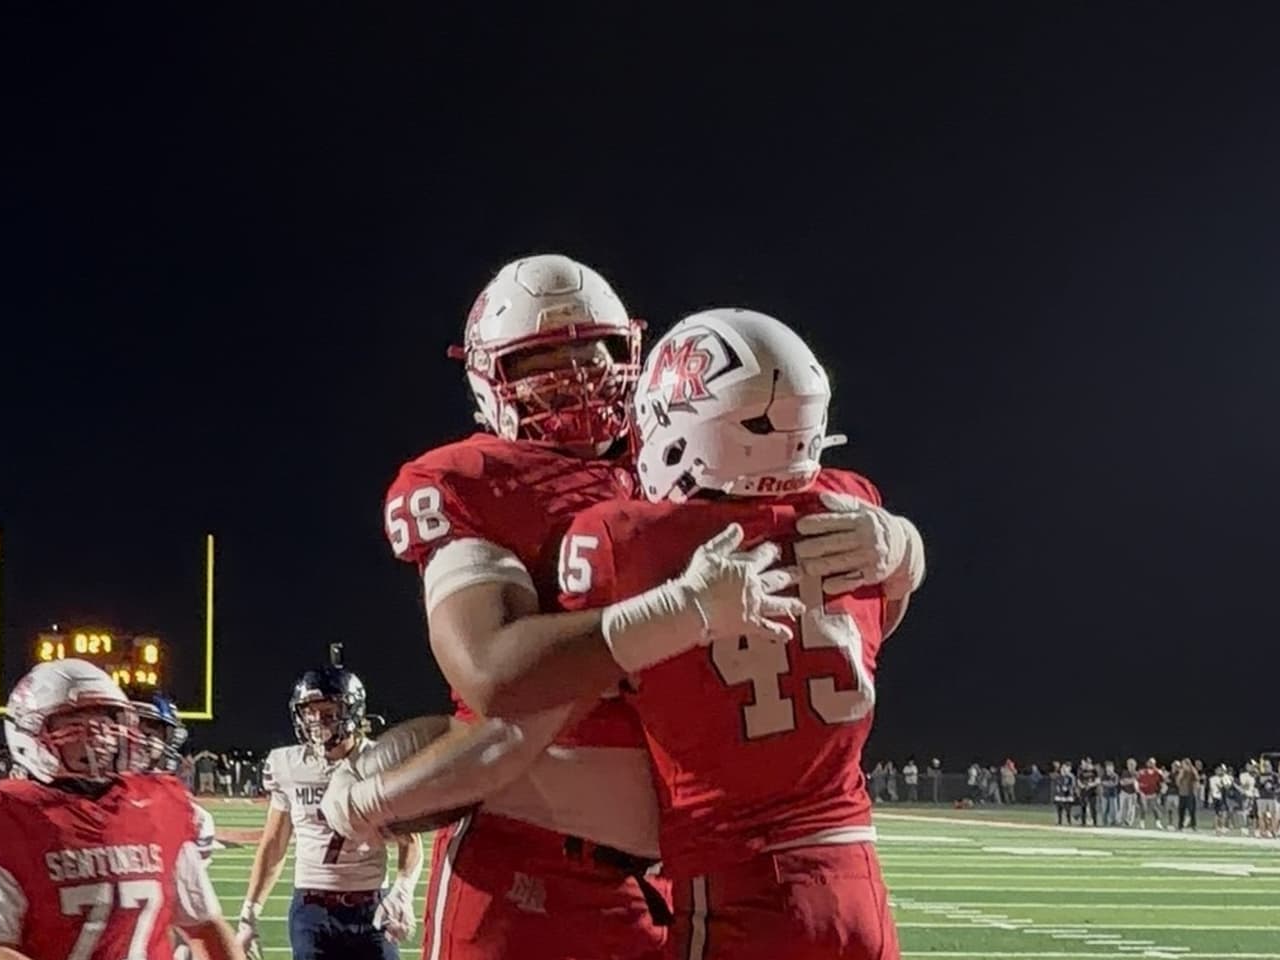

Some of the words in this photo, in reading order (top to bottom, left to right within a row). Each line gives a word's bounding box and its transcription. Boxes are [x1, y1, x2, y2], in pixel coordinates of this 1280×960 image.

[646, 333, 720, 404] MR
[385, 486, 451, 555] 58
[711, 570, 876, 740] 45
[295, 786, 327, 805] MUS
[45, 843, 164, 881] SENTINELS
